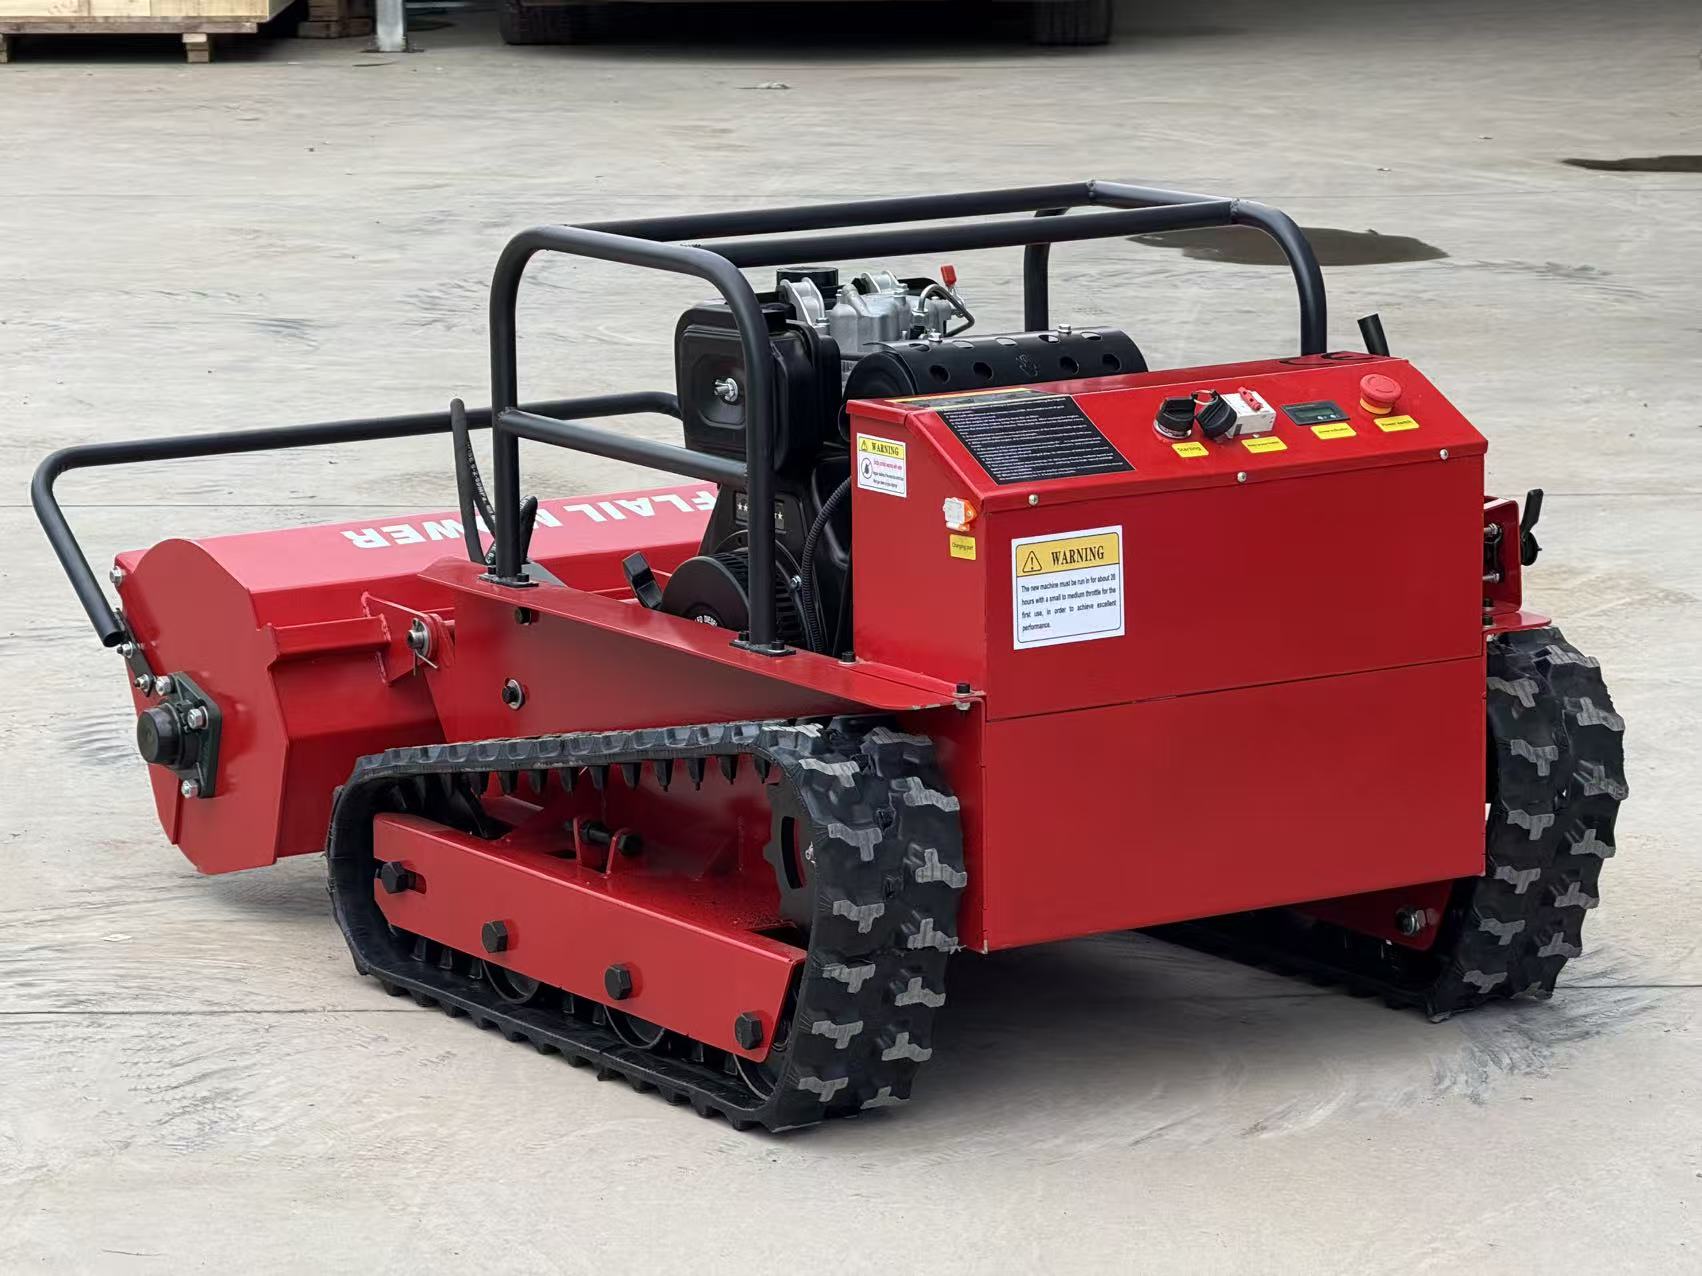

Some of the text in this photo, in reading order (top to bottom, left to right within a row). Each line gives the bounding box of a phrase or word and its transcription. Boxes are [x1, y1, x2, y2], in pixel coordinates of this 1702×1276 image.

[872, 442, 899, 456] WARNING
[563, 490, 718, 523] FLAIL
[1051, 545, 1105, 566] WARNING
[1040, 582, 1058, 590] machine
[1060, 580, 1070, 588] must
[1021, 598, 1034, 606] hours
[1036, 596, 1044, 604] with
[1049, 594, 1061, 602] small
[1067, 591, 1084, 599] medium
[1085, 588, 1101, 597] throttle
[1021, 611, 1031, 619] first
[1077, 602, 1094, 611] achieve
[1097, 600, 1116, 609] excellent
[1022, 622, 1051, 632] performance.
